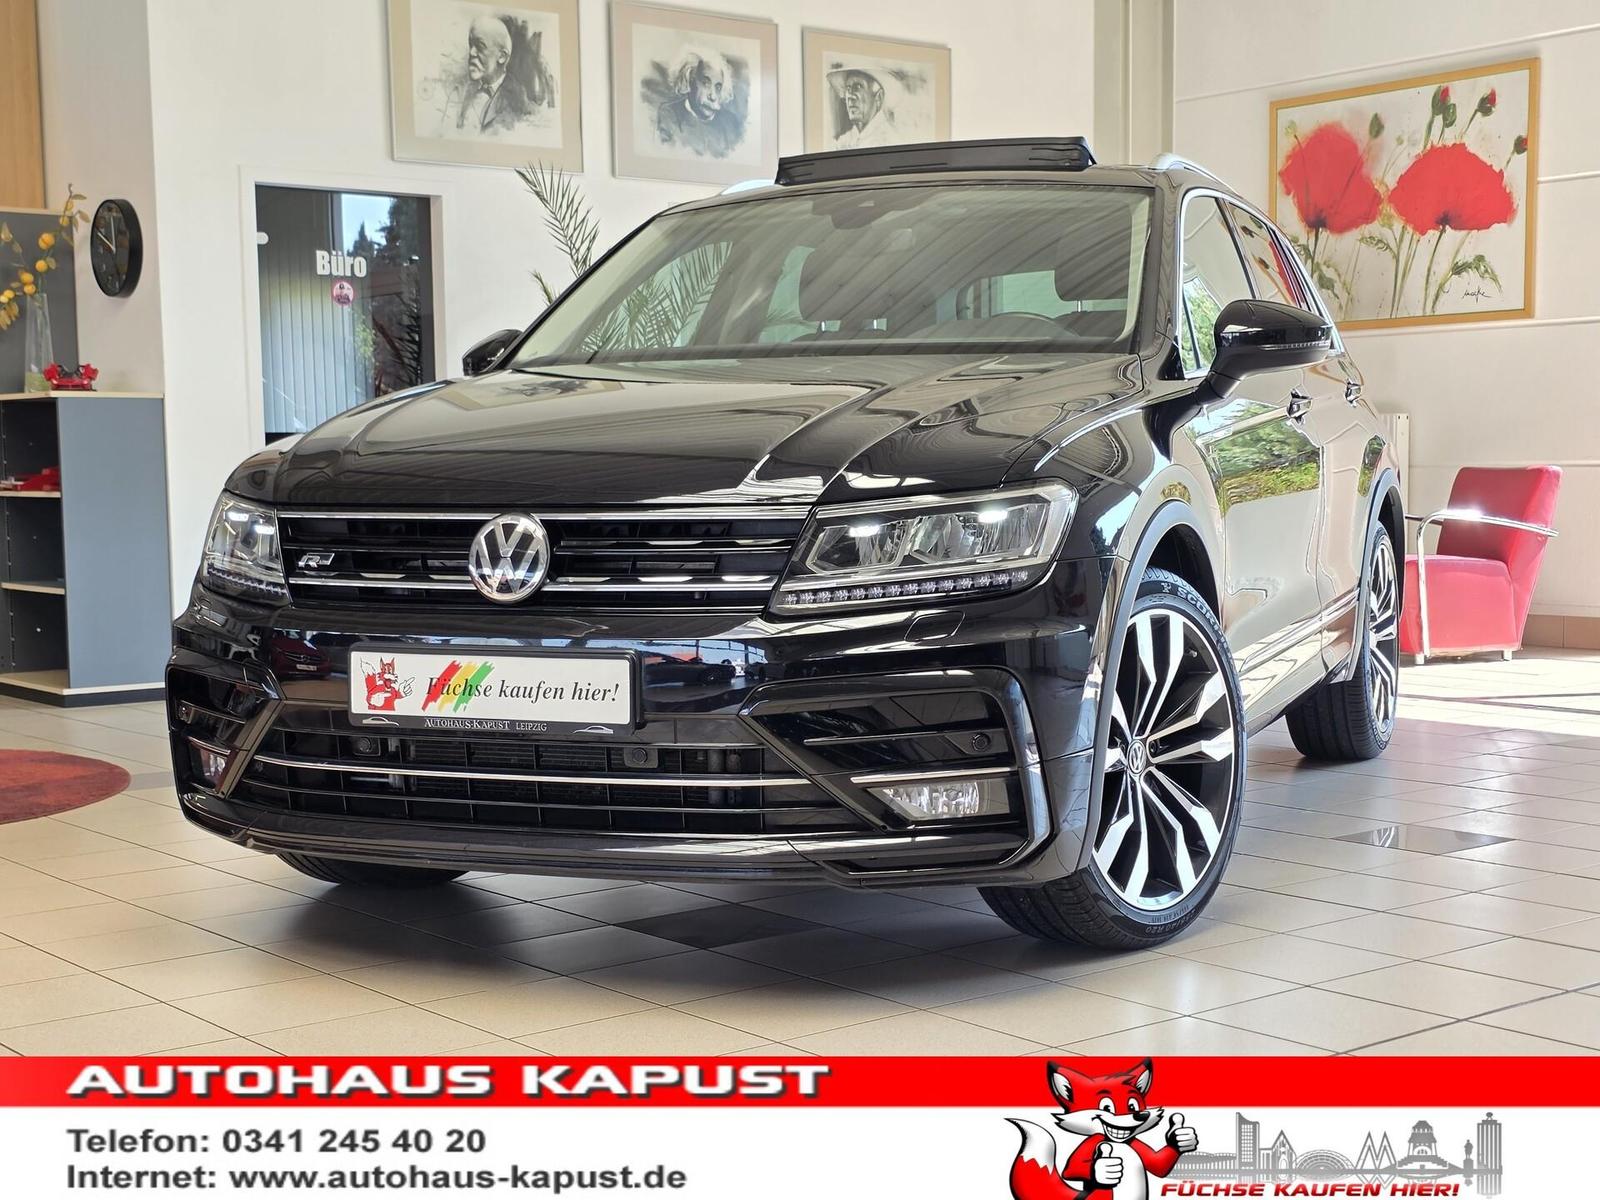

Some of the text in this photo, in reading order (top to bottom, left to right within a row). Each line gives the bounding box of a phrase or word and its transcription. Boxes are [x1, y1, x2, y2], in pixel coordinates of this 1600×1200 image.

[315, 249, 367, 279] Büro
[426, 675, 621, 704] Füchse kaufen hier!
[424, 718, 548, 732] AUTOHAUS-KAPUST LEIPZIG
